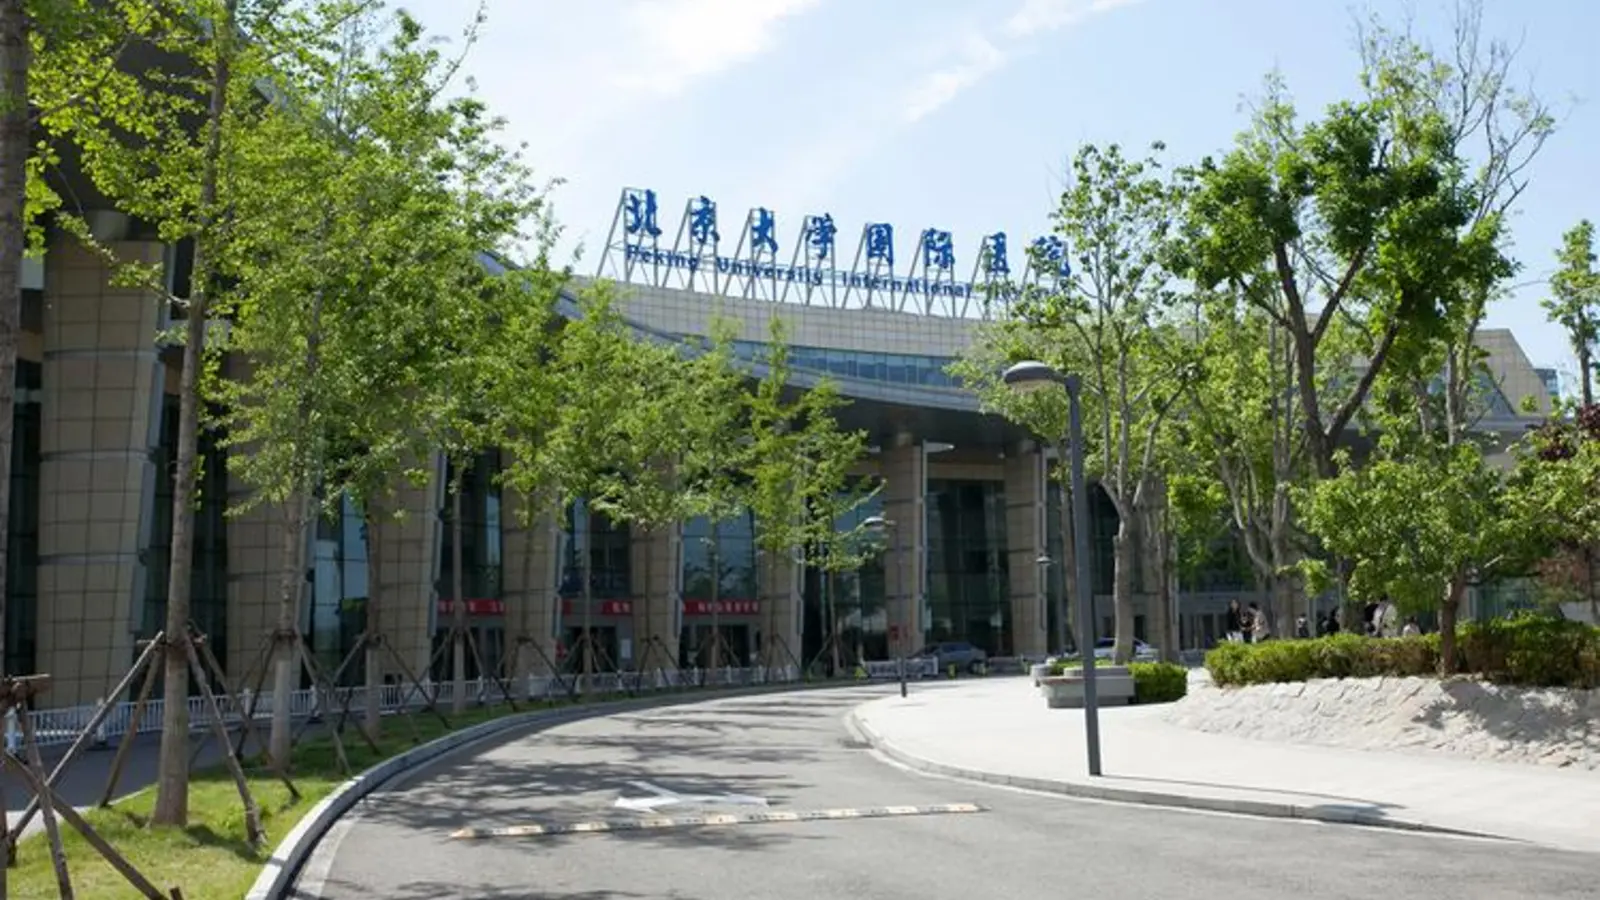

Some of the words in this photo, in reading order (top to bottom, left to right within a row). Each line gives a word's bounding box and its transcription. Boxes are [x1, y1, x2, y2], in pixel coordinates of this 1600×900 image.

[626, 244, 699, 273] Peking
[716, 257, 823, 285] University
[842, 271, 972, 297] International
